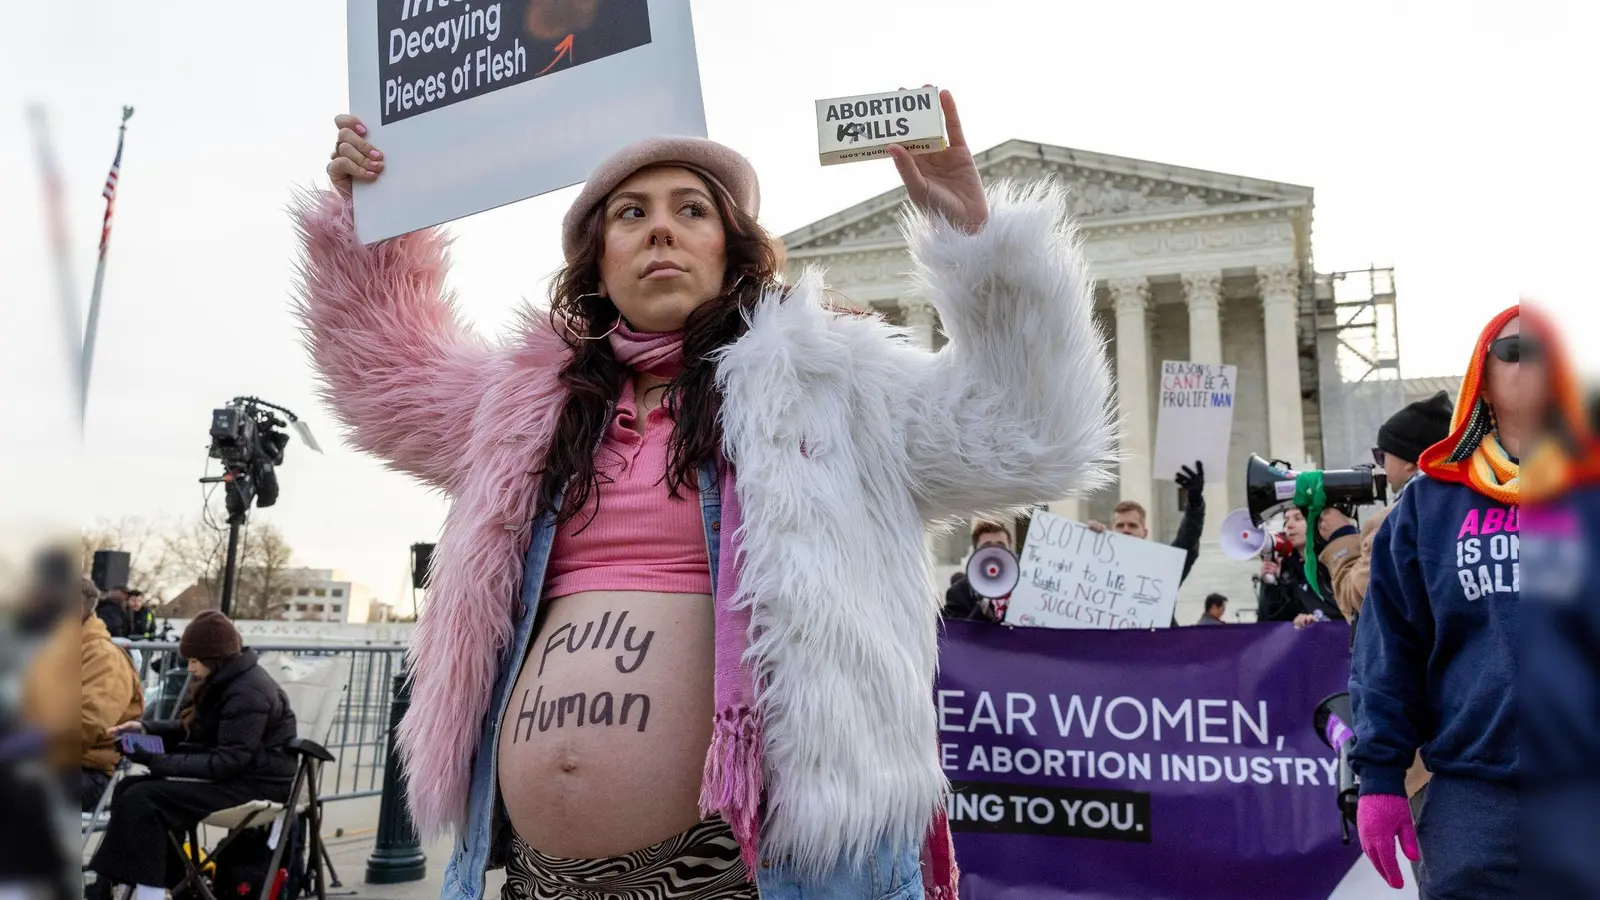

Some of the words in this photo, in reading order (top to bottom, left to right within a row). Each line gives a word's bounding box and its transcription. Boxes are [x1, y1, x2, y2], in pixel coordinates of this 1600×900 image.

[388, 2, 501, 65] Decaying
[385, 71, 446, 116] Pieces
[451, 52, 471, 94] of
[476, 37, 527, 87] Flesh
[825, 93, 931, 122] ABORTION
[840, 143, 930, 159] StopAionRx.com
[1164, 362, 1212, 376] REASONS
[1217, 365, 1226, 377] I
[1204, 376, 1215, 390] BE
[1221, 377, 1229, 390] A
[1210, 392, 1232, 408] MAN
[1456, 538, 1481, 567] IS
[1028, 544, 1042, 564] The
[1047, 556, 1074, 574] right
[1083, 563, 1098, 583] to
[1106, 570, 1127, 592] life
[1133, 574, 1164, 602] IS
[1074, 582, 1122, 610] NOT
[1127, 606, 1138, 618] a
[537, 610, 655, 678] Fully
[513, 685, 651, 744] Human
[936, 690, 1038, 736] EAR
[1049, 694, 1286, 751] WOMEN,
[941, 743, 959, 770] E
[967, 744, 1151, 781] ABORTION
[1161, 753, 1339, 787] INDUSTRY
[1009, 795, 1055, 825] TO
[1060, 798, 1144, 831] YOU.
